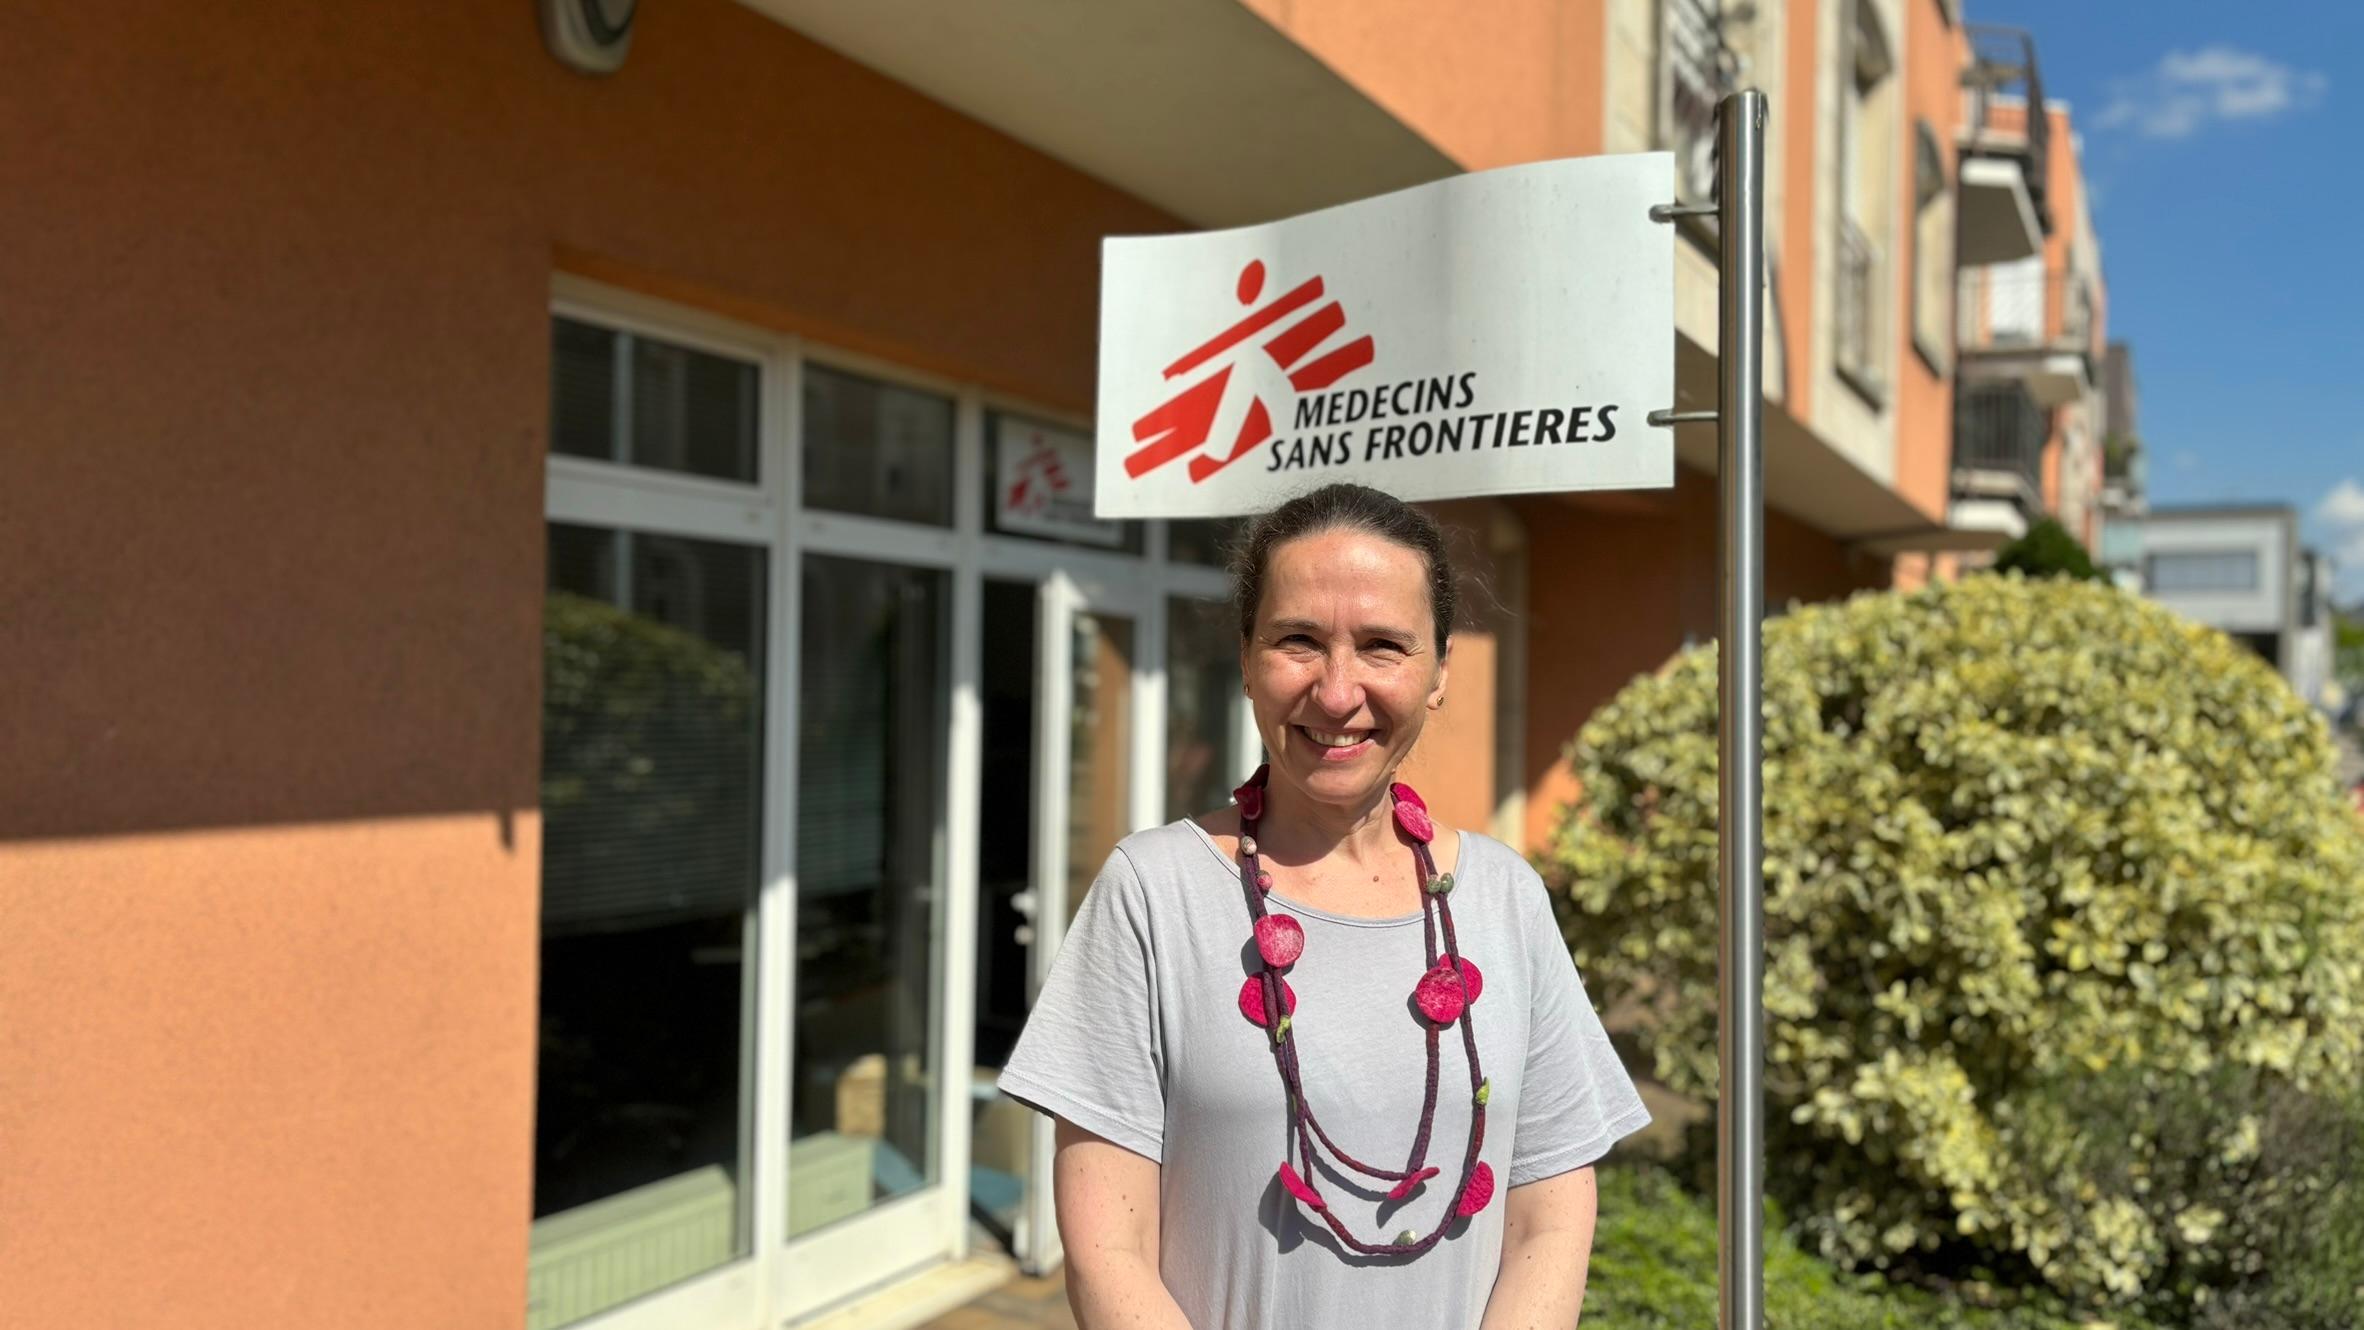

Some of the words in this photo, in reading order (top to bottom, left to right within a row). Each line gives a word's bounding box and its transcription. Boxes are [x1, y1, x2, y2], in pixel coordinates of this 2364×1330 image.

[1293, 371, 1477, 430] MEDECINS
[1267, 430, 1353, 472] SANS
[1364, 404, 1619, 463] FRONTIERES
